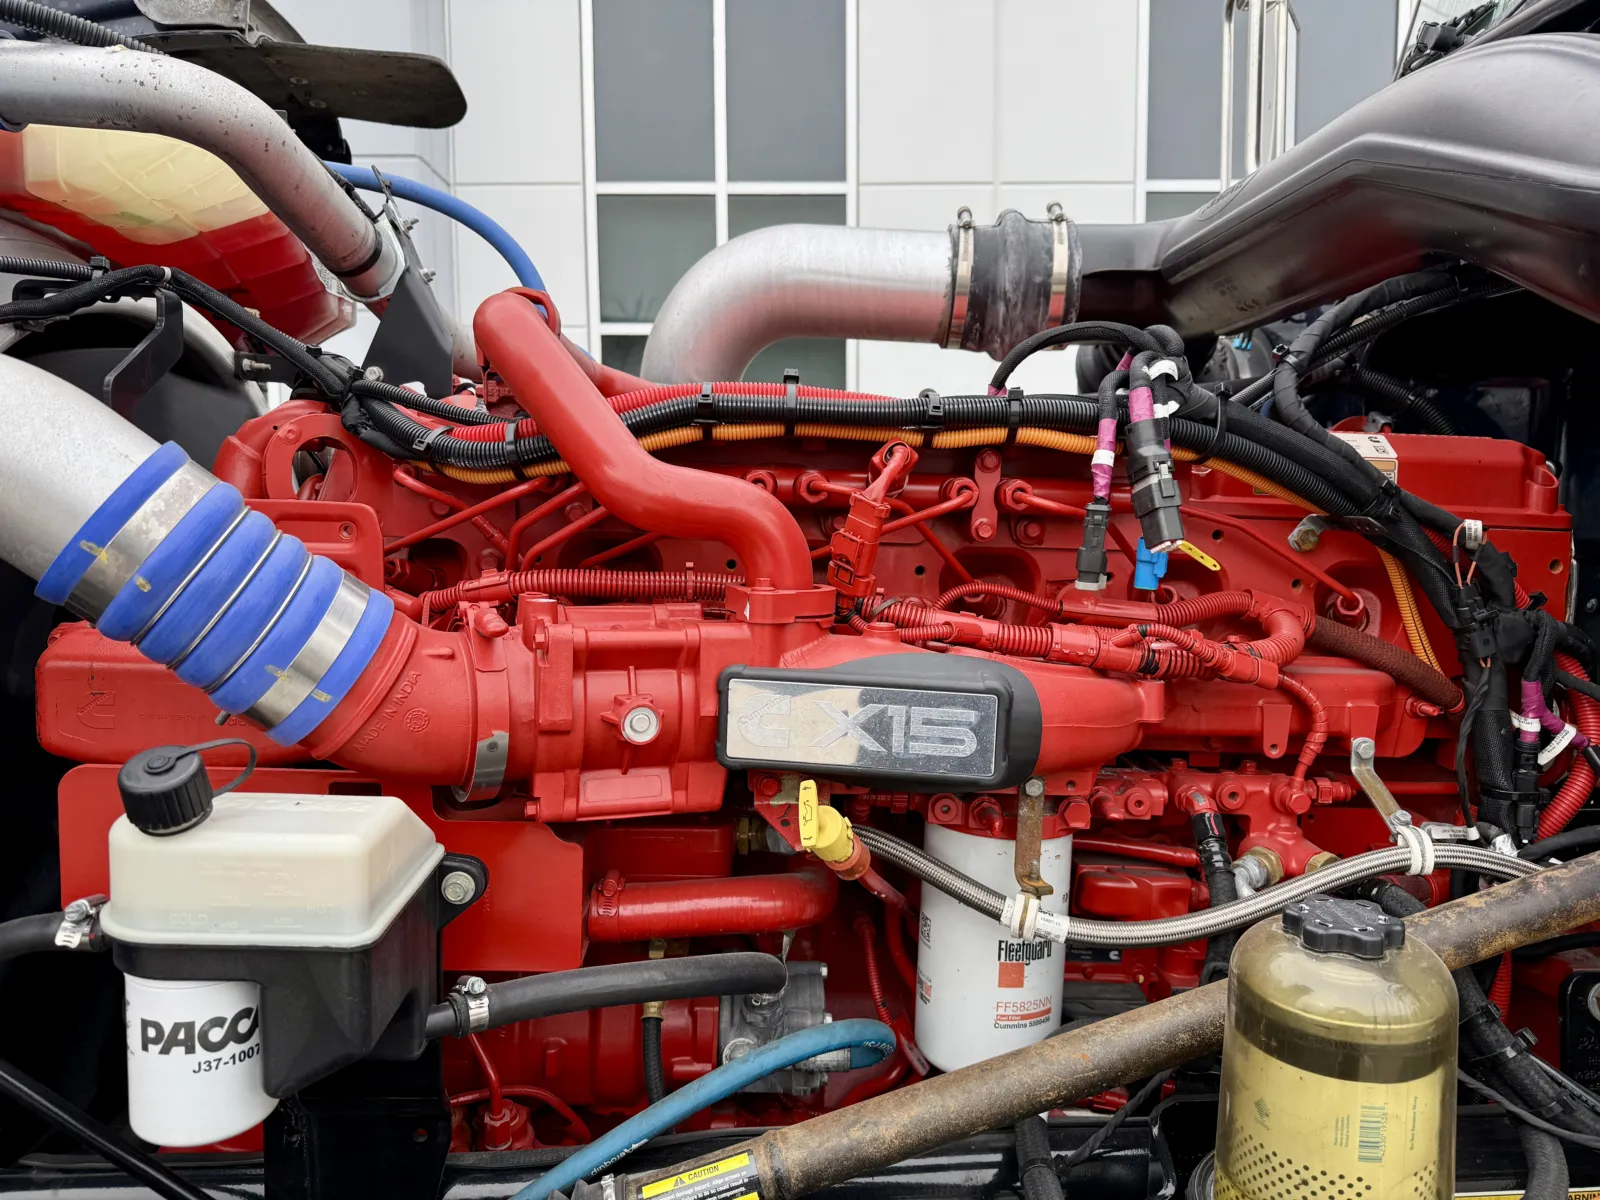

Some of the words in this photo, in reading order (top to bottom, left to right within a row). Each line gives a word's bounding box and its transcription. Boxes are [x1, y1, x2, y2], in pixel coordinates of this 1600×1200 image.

[352, 720, 387, 753] MADE
[382, 705, 398, 721] IN
[393, 671, 421, 706] INDIA
[809, 700, 978, 758] X15
[998, 940, 1052, 965] Fleetguard
[996, 996, 1052, 1013] FF5825NN
[688, 1165, 719, 1180] CAUTION
